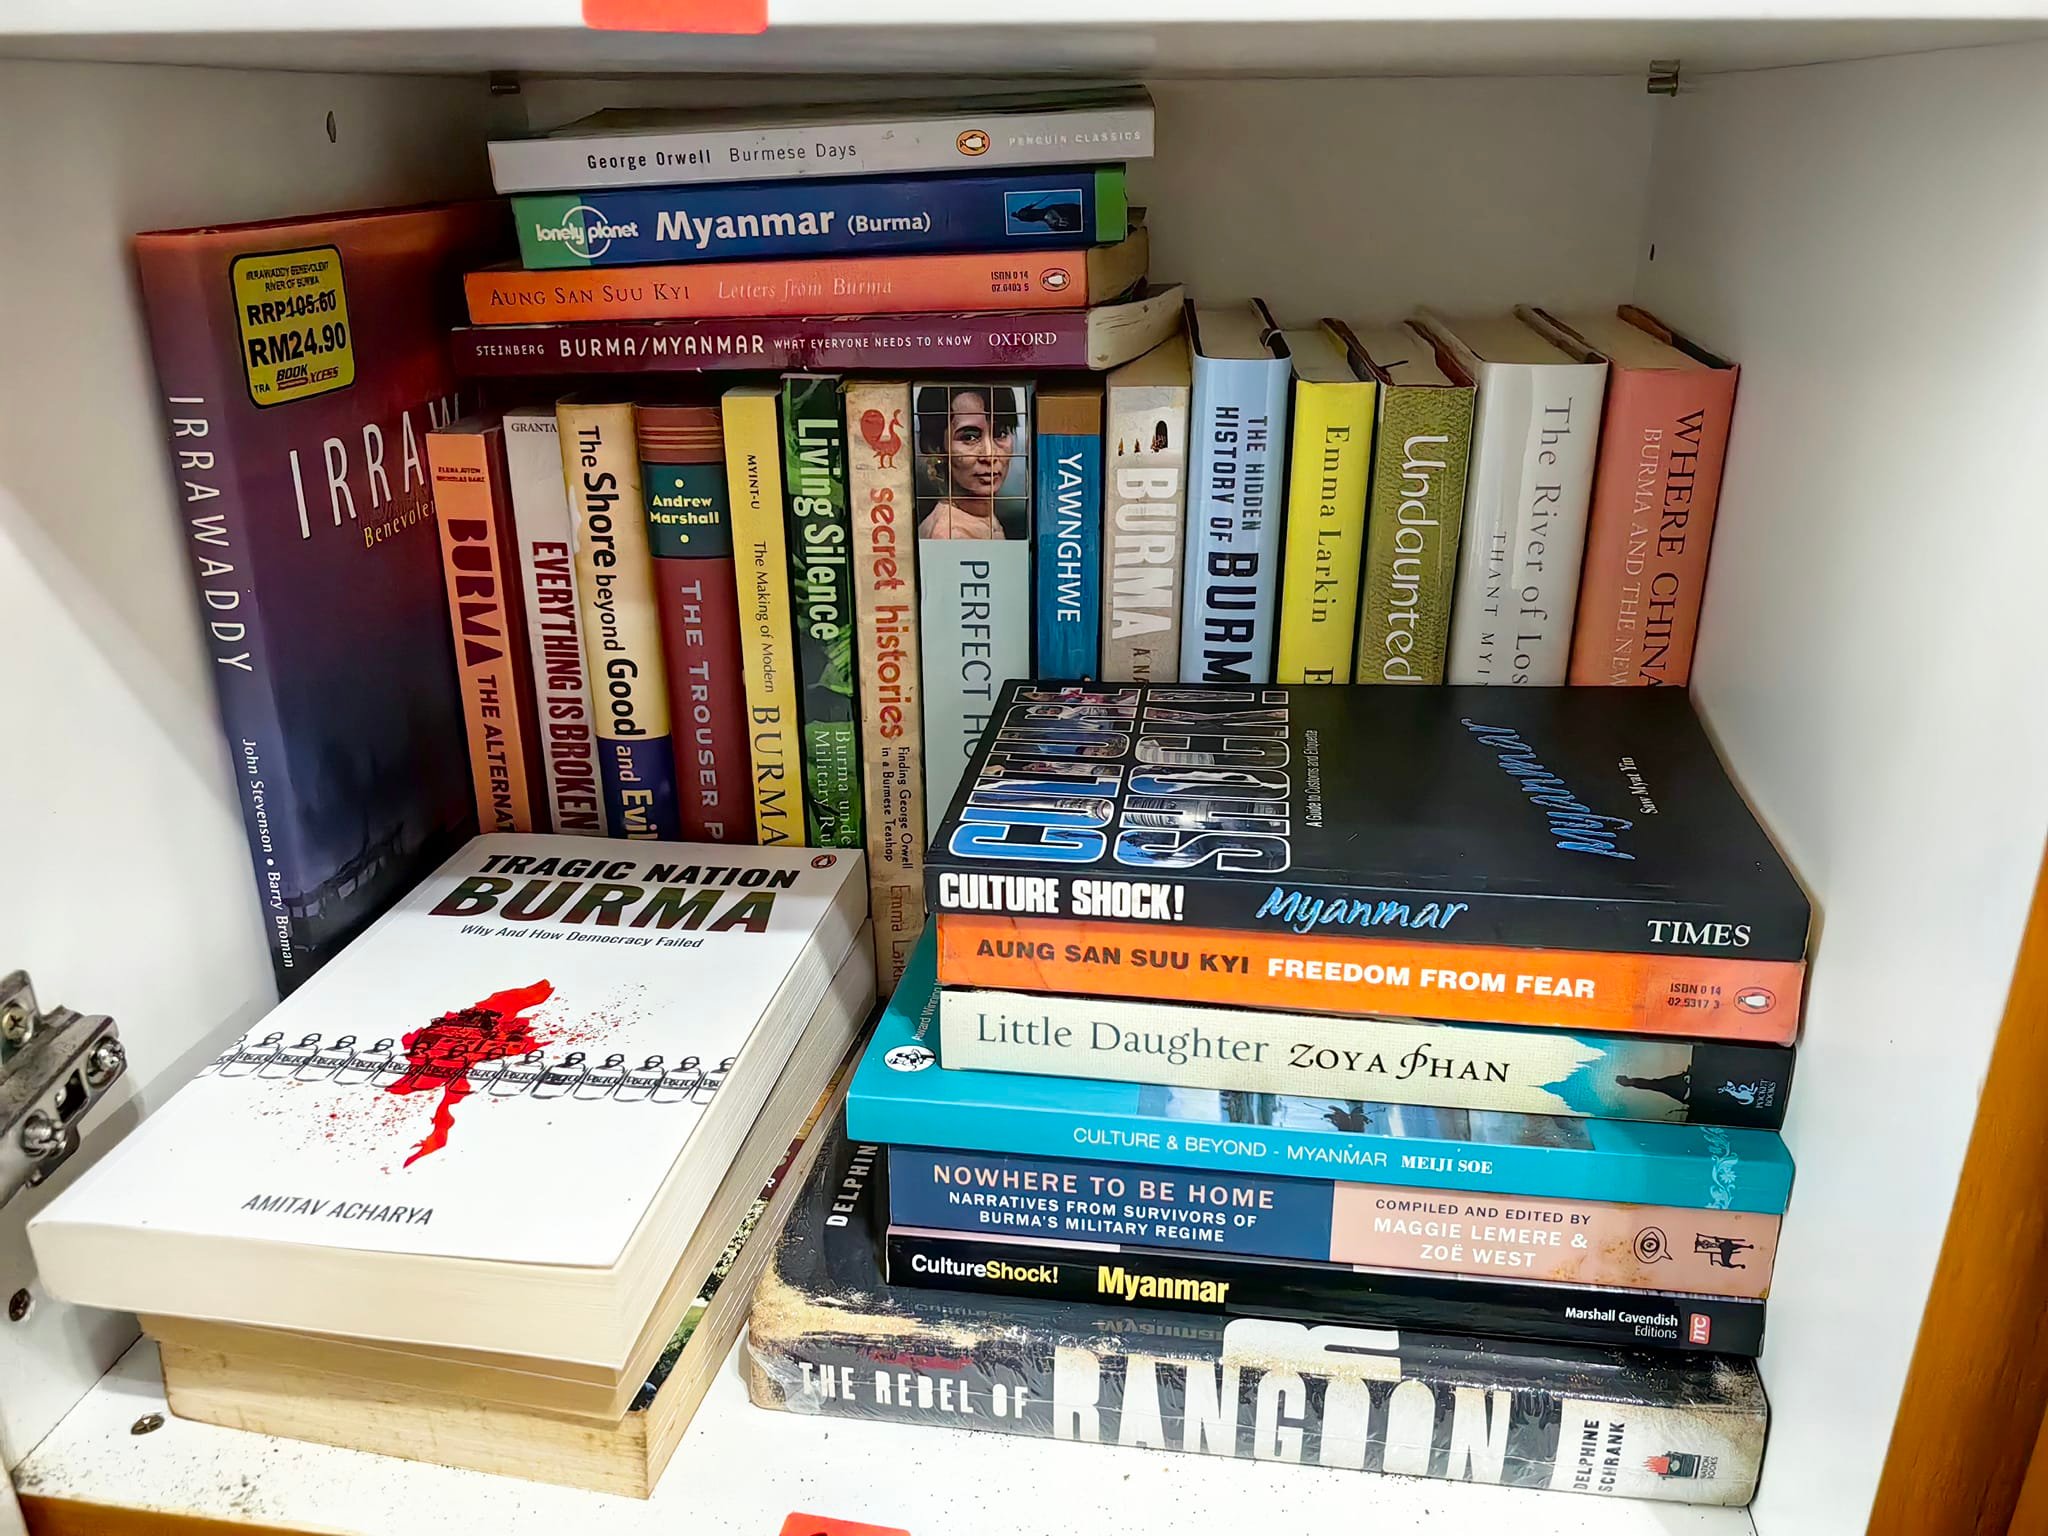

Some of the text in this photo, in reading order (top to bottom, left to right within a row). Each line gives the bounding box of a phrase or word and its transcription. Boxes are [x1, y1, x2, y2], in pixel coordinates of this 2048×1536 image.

[587, 143, 857, 171] George Orwell Burmese Days
[1008, 131, 1142, 147] PENGUIN CLASSICS
[535, 219, 639, 246] lonely planet
[656, 210, 932, 249] Myanmar (Burma)
[717, 277, 892, 300] Letters from Burma
[248, 322, 347, 367] RM24.90
[475, 344, 545, 357] STEINBERG
[560, 334, 766, 358] BURMA/MYANMAR
[773, 335, 973, 351] WHAT EVERYONE NEEDS TO KNOW
[988, 332, 1057, 347] OXFORD
[747, 454, 761, 510] MYINT-U
[1241, 415, 1268, 530] THE HIDDEN
[650, 511, 720, 525] Marshall
[652, 495, 713, 507] Andrew
[168, 397, 253, 672] IRRAWADDY
[793, 419, 846, 640] Living Silence
[1057, 453, 1083, 623] YAWNGHWE
[1202, 407, 1259, 683] HISTORY OF BURM
[1311, 424, 1350, 623] Emma Larkin
[1511, 397, 1573, 685] The River of Los
[1111, 468, 1180, 640] BURMA
[1382, 435, 1449, 682] Undaunted
[1609, 428, 1664, 686] BURMA AND THE NEW
[1638, 408, 1705, 687] WHERE CHINA
[578, 425, 658, 840] The Shore beyond Good and Evil
[870, 487, 912, 740] secret histories
[960, 560, 992, 701] PERFECT
[532, 541, 601, 831] EVERYTHING IS BROKEN
[680, 579, 719, 808] THE TROUSER
[752, 541, 790, 847] The Making of Modern BURMA
[882, 747, 891, 757] in
[1303, 730, 1320, 755] Etiquette
[1304, 756, 1319, 767] and
[242, 738, 273, 854] John Stevenson
[882, 771, 895, 816] Burmese
[949, 685, 1142, 864] CULTURE
[1113, 689, 1291, 874] SHOCK!
[1304, 767, 1321, 794] Customs
[1461, 717, 1637, 861] Myanmar
[1618, 757, 1659, 813] Saw Myat Yin
[897, 746, 914, 869] Finding George Orwell
[1305, 803, 1323, 821] Guide
[885, 818, 898, 862] Teashop
[479, 854, 801, 889] TRAGIC NATION
[427, 875, 778, 934] BURMA
[939, 872, 1185, 921] CULTURE SHOCK!
[1255, 887, 1469, 934] Myanmar
[266, 871, 295, 968] Barry Broman
[460, 923, 703, 949] Why And How Democracy Failed
[1647, 920, 1752, 948] TIMES
[976, 938, 1249, 974] AUNG SAN SUU KYI
[1267, 957, 1596, 999] FREEDOM FROM FEAR
[977, 1013, 1270, 1066] Little Daughter
[1287, 1043, 1511, 1083] ZOYA PHAN
[1073, 1126, 1389, 1168] CULTURE & BEYOND MYANMAR
[1400, 1155, 1494, 1175] MEIJI SOE
[932, 1164, 1275, 1210] NOWHERE TO BE HOME
[241, 1193, 434, 1227] AMITAV ACHARYA
[949, 1191, 1257, 1228] NARRATIVES FROM SURVIVORS OF
[979, 1210, 1225, 1243] BURMA'S MILITARY REGIME
[1375, 1198, 1592, 1226] COMPILED AND EDITED BY
[1373, 1217, 1589, 1250] MAGGIE LEMERE &
[1420, 1242, 1537, 1269] ZOË WEST
[911, 1254, 1059, 1284] CultureShock!
[1097, 1266, 1229, 1304] Myanmar
[1565, 1306, 1679, 1328] Marshall Cavendish
[1634, 1324, 1678, 1340] Editions
[799, 1361, 856, 1401] THE
[874, 1370, 974, 1414] REBEL
[992, 1383, 1029, 1419] OF
[1053, 1345, 1512, 1487] RANGOON
[1572, 1419, 1600, 1490] DELPHINE
[1598, 1422, 1626, 1492] SCHRANK
